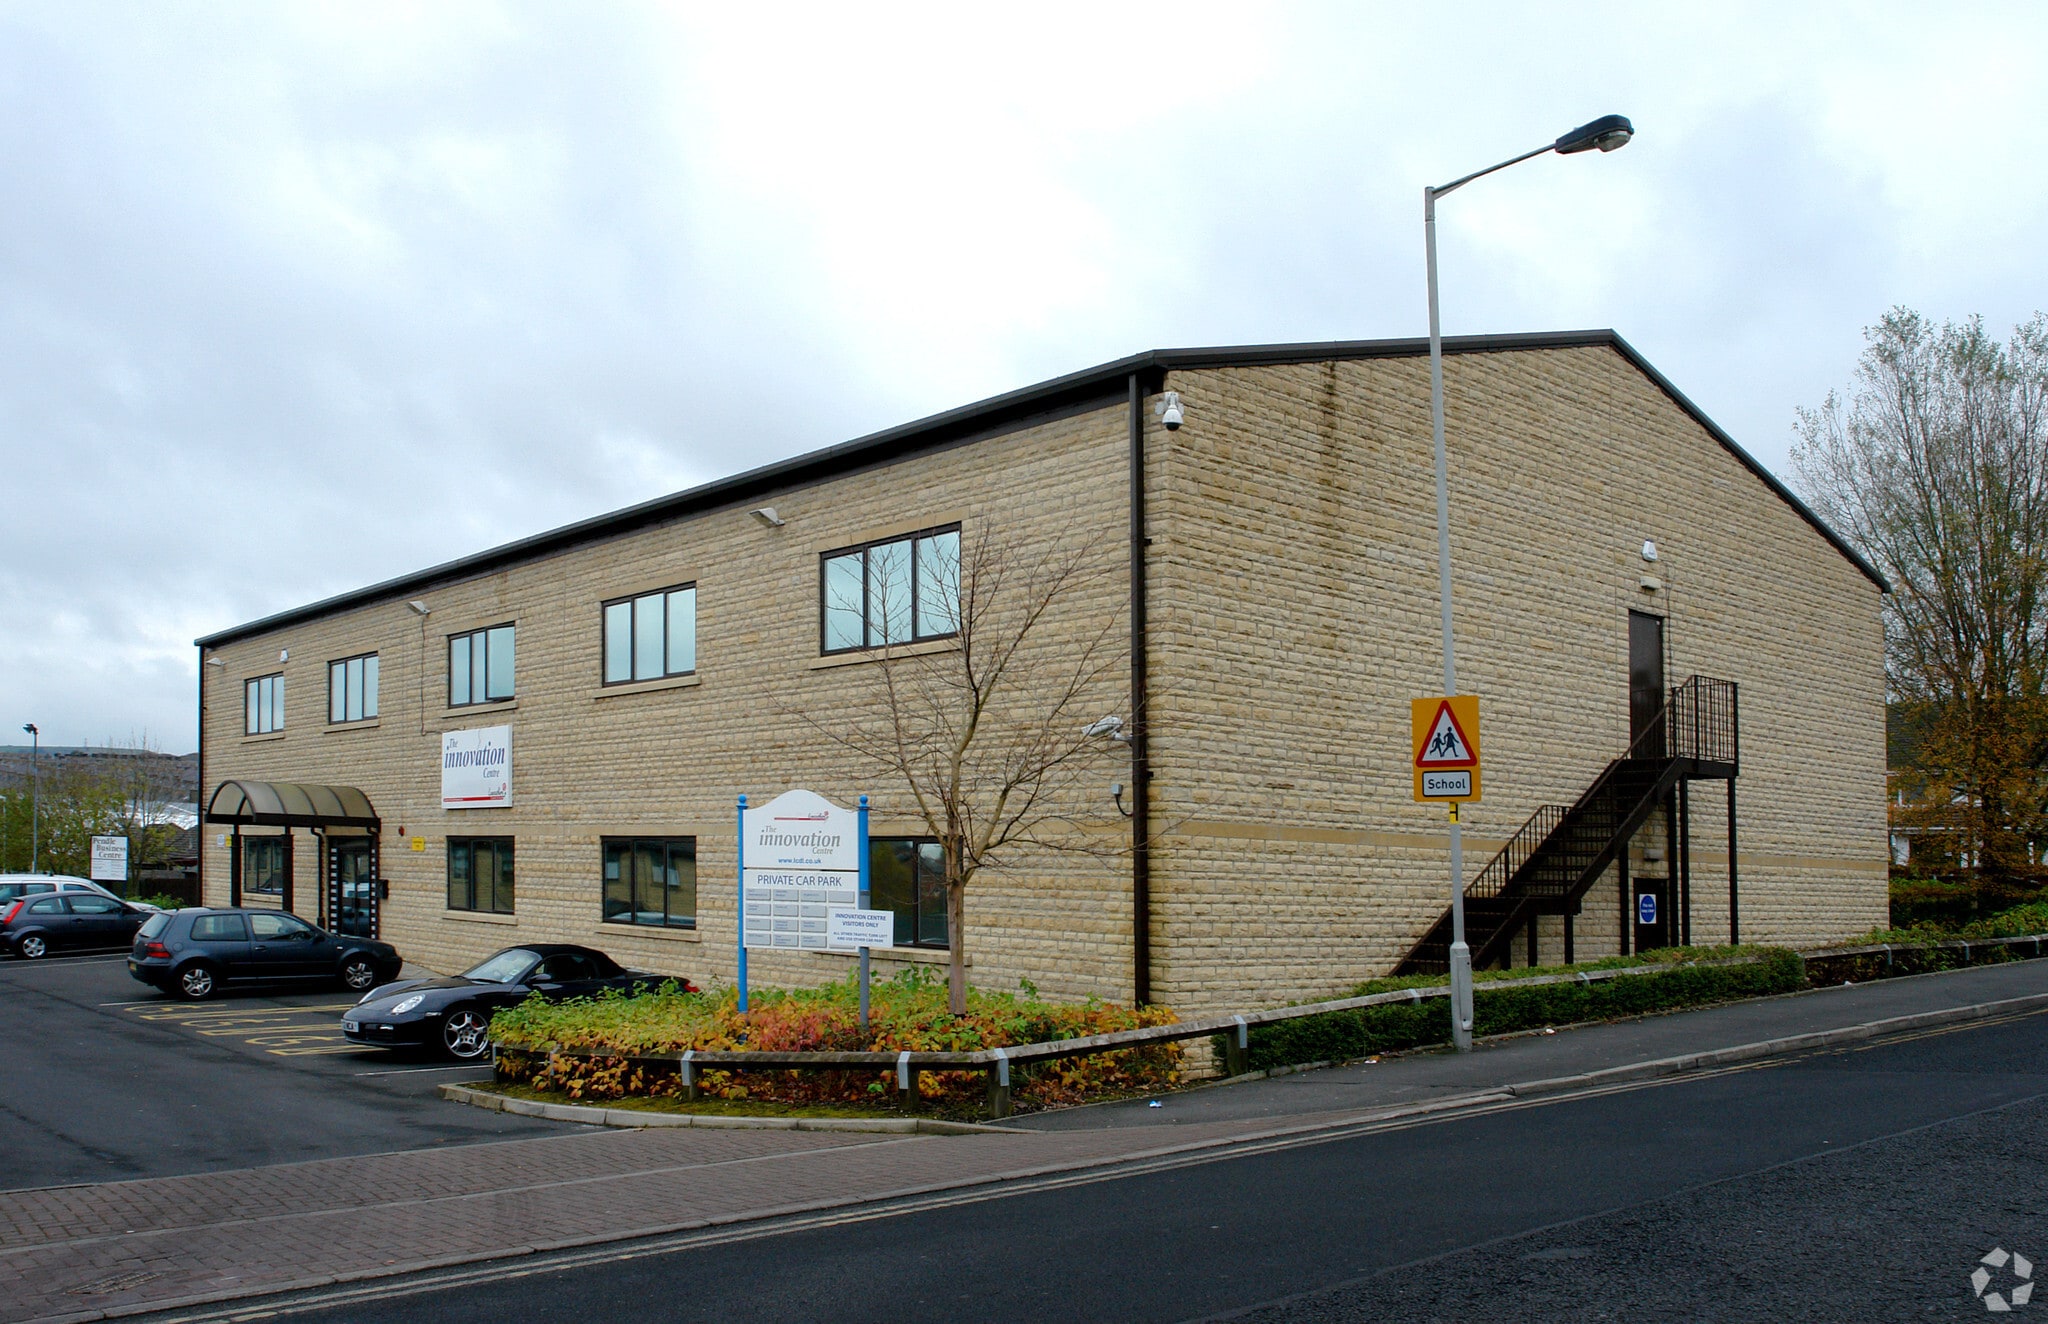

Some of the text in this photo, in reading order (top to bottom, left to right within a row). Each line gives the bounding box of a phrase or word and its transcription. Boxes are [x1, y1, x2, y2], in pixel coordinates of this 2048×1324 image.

[448, 738, 459, 748] The
[444, 740, 506, 769] innovation
[482, 768, 500, 779] Centre
[1427, 778, 1466, 790] School
[764, 825, 777, 833] The
[758, 829, 841, 848] innovation
[812, 847, 834, 855] Centre
[757, 874, 842, 887] PRIVATE CAR PARK
